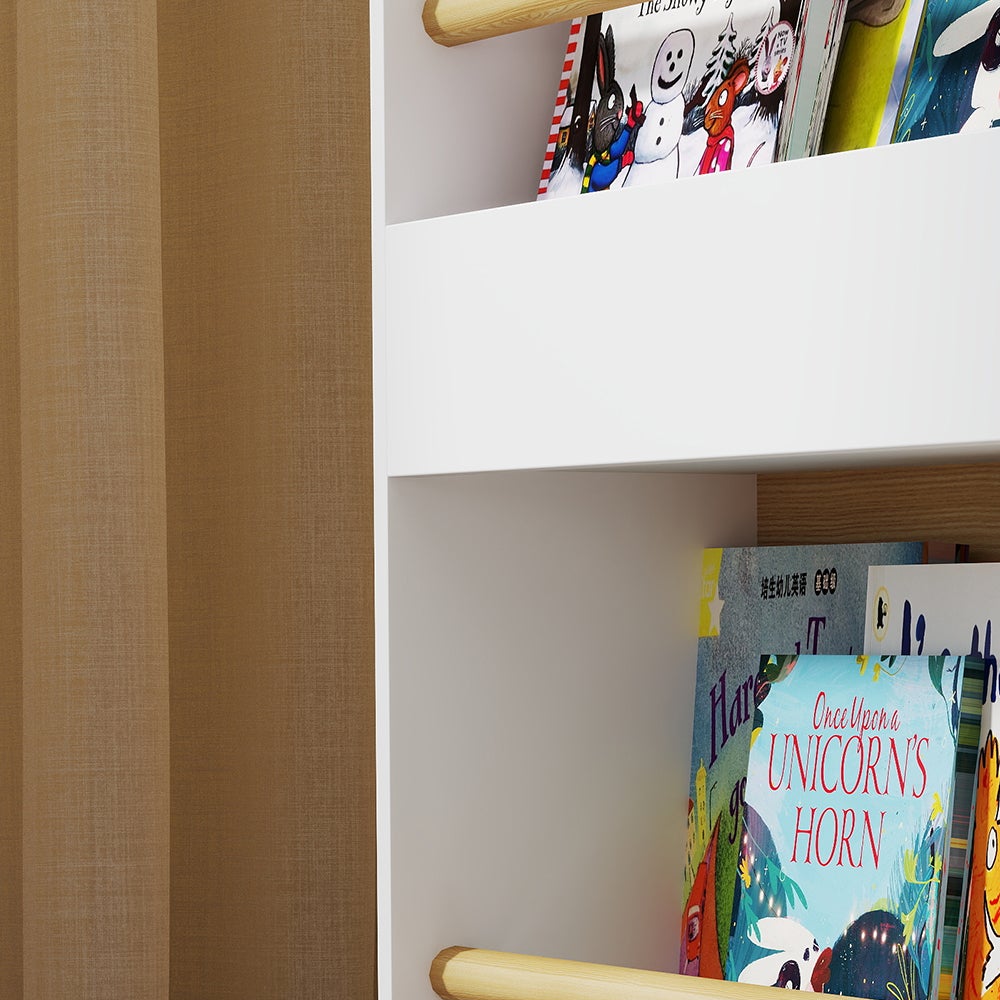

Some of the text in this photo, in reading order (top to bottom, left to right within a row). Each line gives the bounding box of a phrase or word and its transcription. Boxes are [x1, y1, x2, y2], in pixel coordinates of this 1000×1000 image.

[760, 572, 807, 600] 培生幼儿英语
[708, 668, 760, 768] Har
[813, 691, 901, 753] Once Upon a
[768, 733, 929, 798] UNICORN'S
[790, 806, 887, 870] HORN
